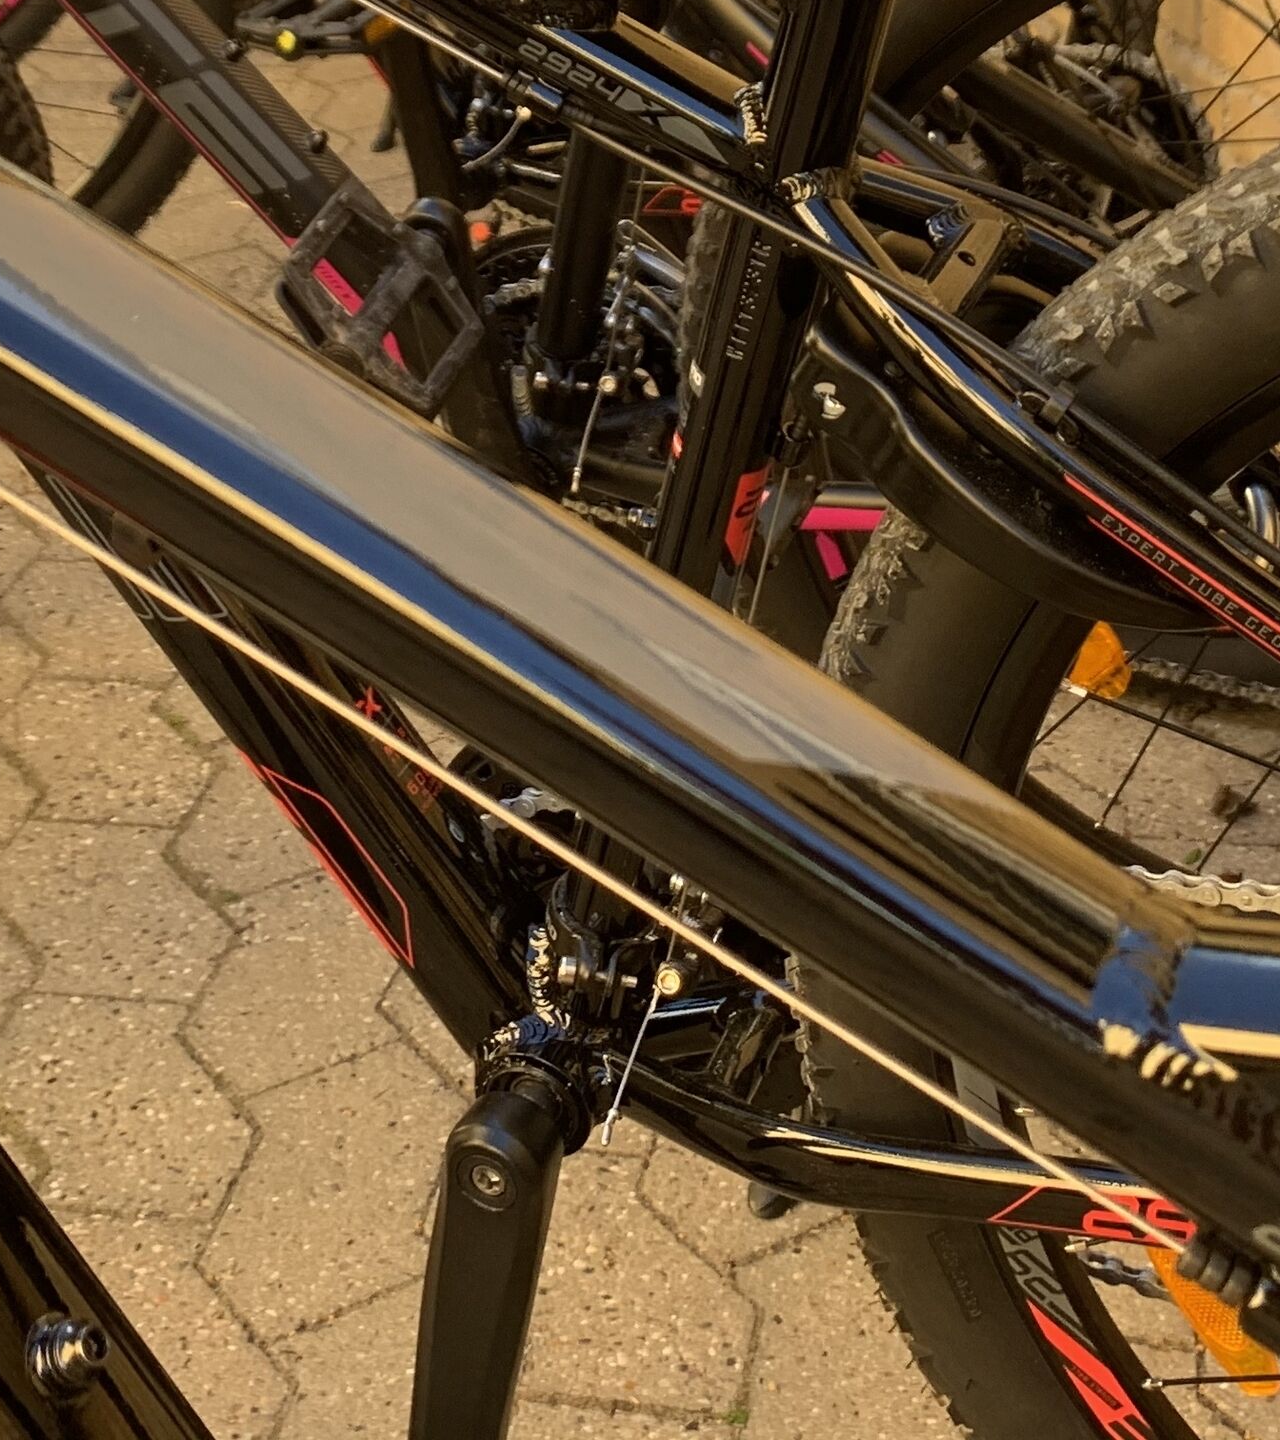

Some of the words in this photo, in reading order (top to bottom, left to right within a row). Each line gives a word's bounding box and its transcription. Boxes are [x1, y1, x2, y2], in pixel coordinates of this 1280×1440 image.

[517, 36, 624, 103] 2924
[1100, 513, 1181, 574] EXPERT
[1186, 573, 1240, 617] TUBE
